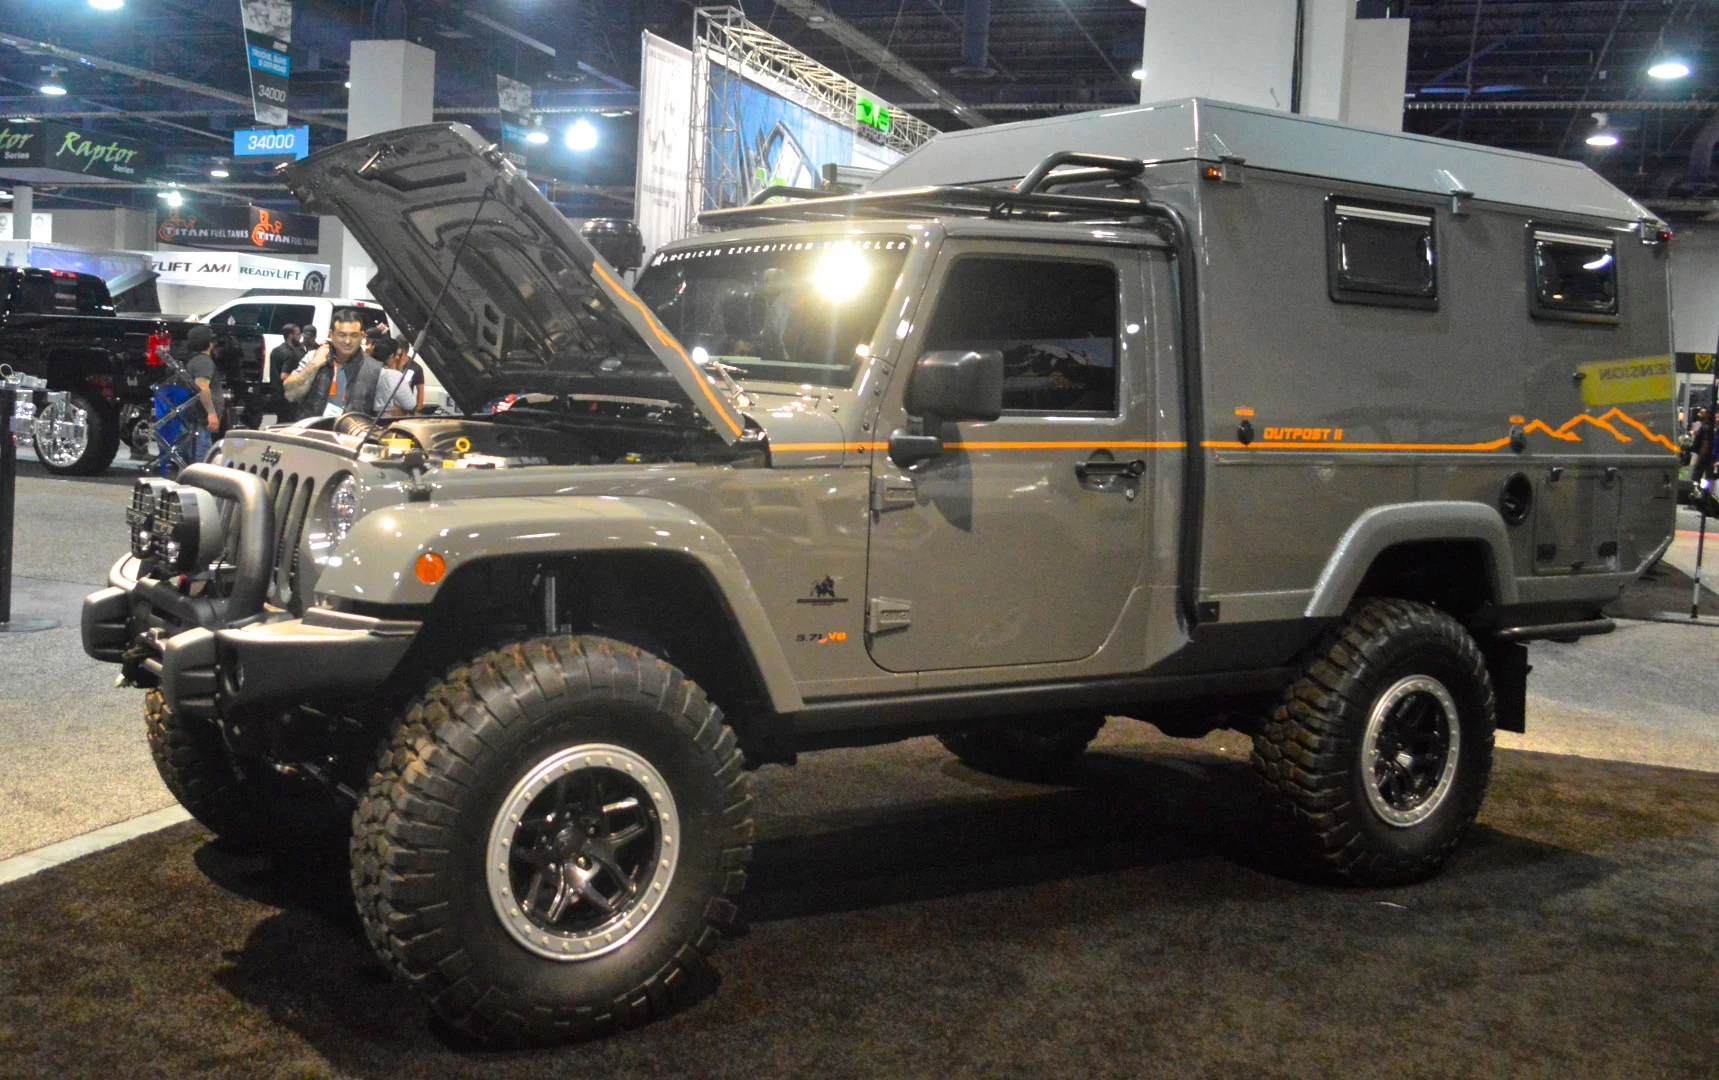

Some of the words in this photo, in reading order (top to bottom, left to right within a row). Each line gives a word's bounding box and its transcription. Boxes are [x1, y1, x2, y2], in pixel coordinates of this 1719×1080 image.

[258, 84, 286, 103] 34000
[248, 133, 295, 150] 34000
[4, 151, 30, 159] Series
[56, 131, 138, 172] Raptor
[112, 163, 135, 174] Series
[164, 226, 208, 237] TITAN
[210, 229, 226, 238] FUEL
[227, 229, 249, 239] TANKS
[257, 230, 291, 244] TITAN
[662, 248, 721, 263] AMERICAN
[728, 242, 813, 255] EXPEDITION
[823, 240, 906, 250] VICLES
[239, 266, 301, 281] READYLIFT
[1263, 427, 1331, 440] OUTPOST
[828, 631, 848, 641] V8
